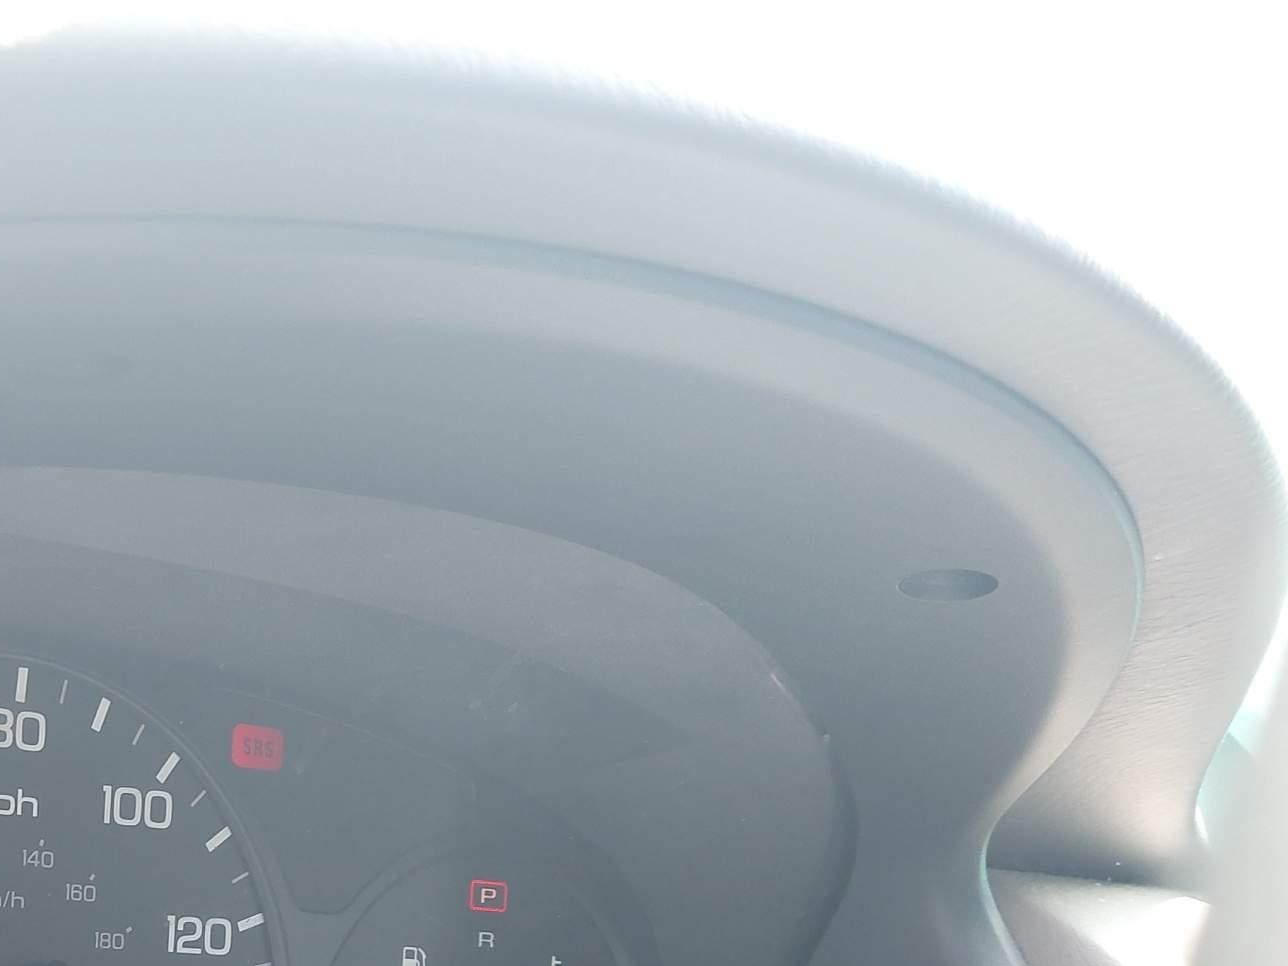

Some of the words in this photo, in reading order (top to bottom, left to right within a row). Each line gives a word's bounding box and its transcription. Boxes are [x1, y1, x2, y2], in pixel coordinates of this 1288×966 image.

[244, 736, 272, 759] SRS
[102, 785, 173, 829] 100
[22, 849, 54, 869] 140
[66, 883, 96, 902] 160
[480, 888, 497, 904] P
[95, 931, 125, 950] 180
[167, 915, 232, 956] 120
[478, 931, 495, 948] R
